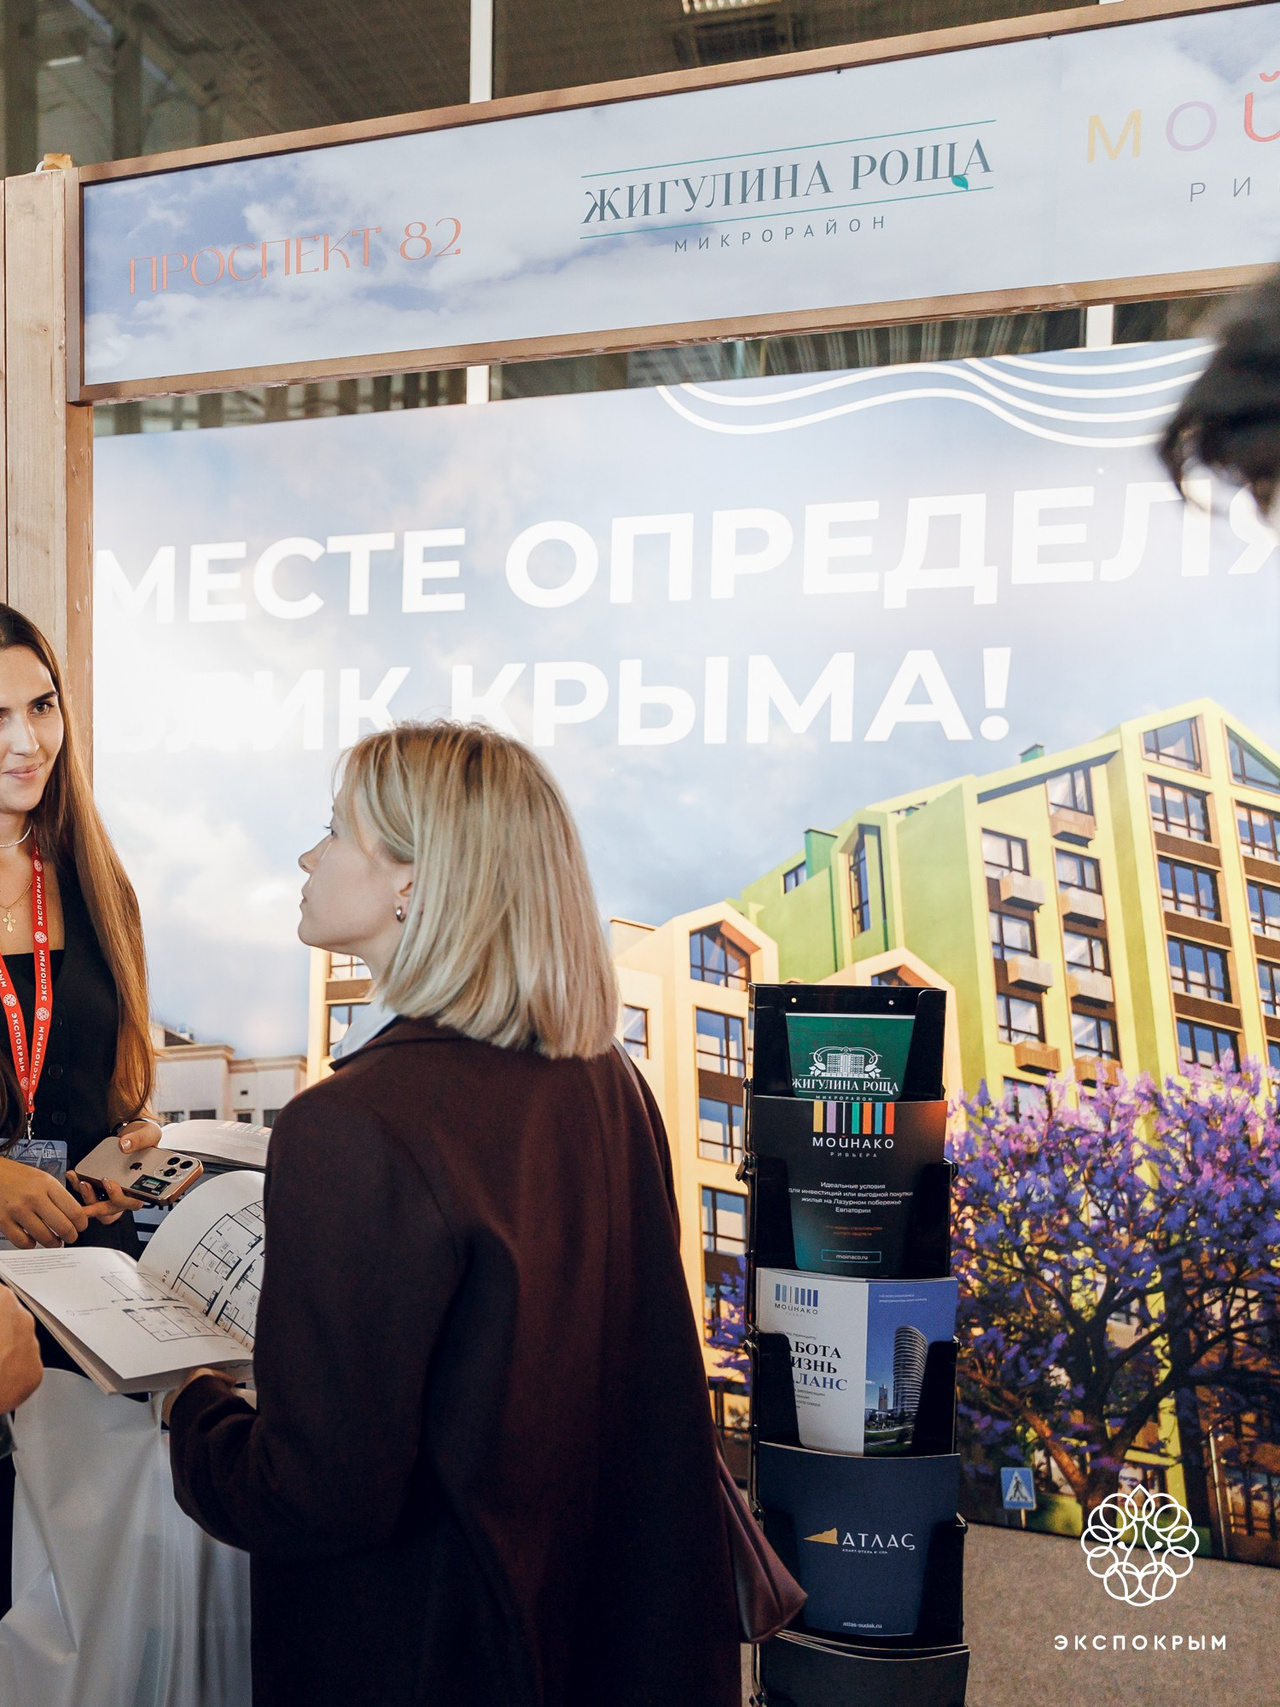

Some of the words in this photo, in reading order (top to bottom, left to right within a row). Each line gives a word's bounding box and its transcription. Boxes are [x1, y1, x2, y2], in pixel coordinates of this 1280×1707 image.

[581, 160, 834, 224] ЖИГУЛИНА
[850, 138, 995, 191] РОЩА
[129, 226, 382, 295] ПРОСПЕКТ
[399, 217, 462, 261] 82
[673, 215, 886, 253] МИКРОРАЙОН
[451, 646, 1012, 747] КРЫМА!
[36, 875, 44, 927] ЭКСПОКРЫМ
[39, 949, 48, 1002] ЭКСПОКРЫМ
[11, 1012, 25, 1072] ЭКСПОКРЫМ
[31, 1026, 44, 1086] ЭКСПОКРЫМ
[792, 1078, 859, 1091] ЖИГУЛИНА
[863, 1081, 899, 1095] РОЩА
[812, 1135, 894, 1149] МОЙНАКО
[820, 1181, 859, 1189] Идеальные
[835, 1206, 872, 1214] Евпатории
[790, 1341, 842, 1359] БОТА
